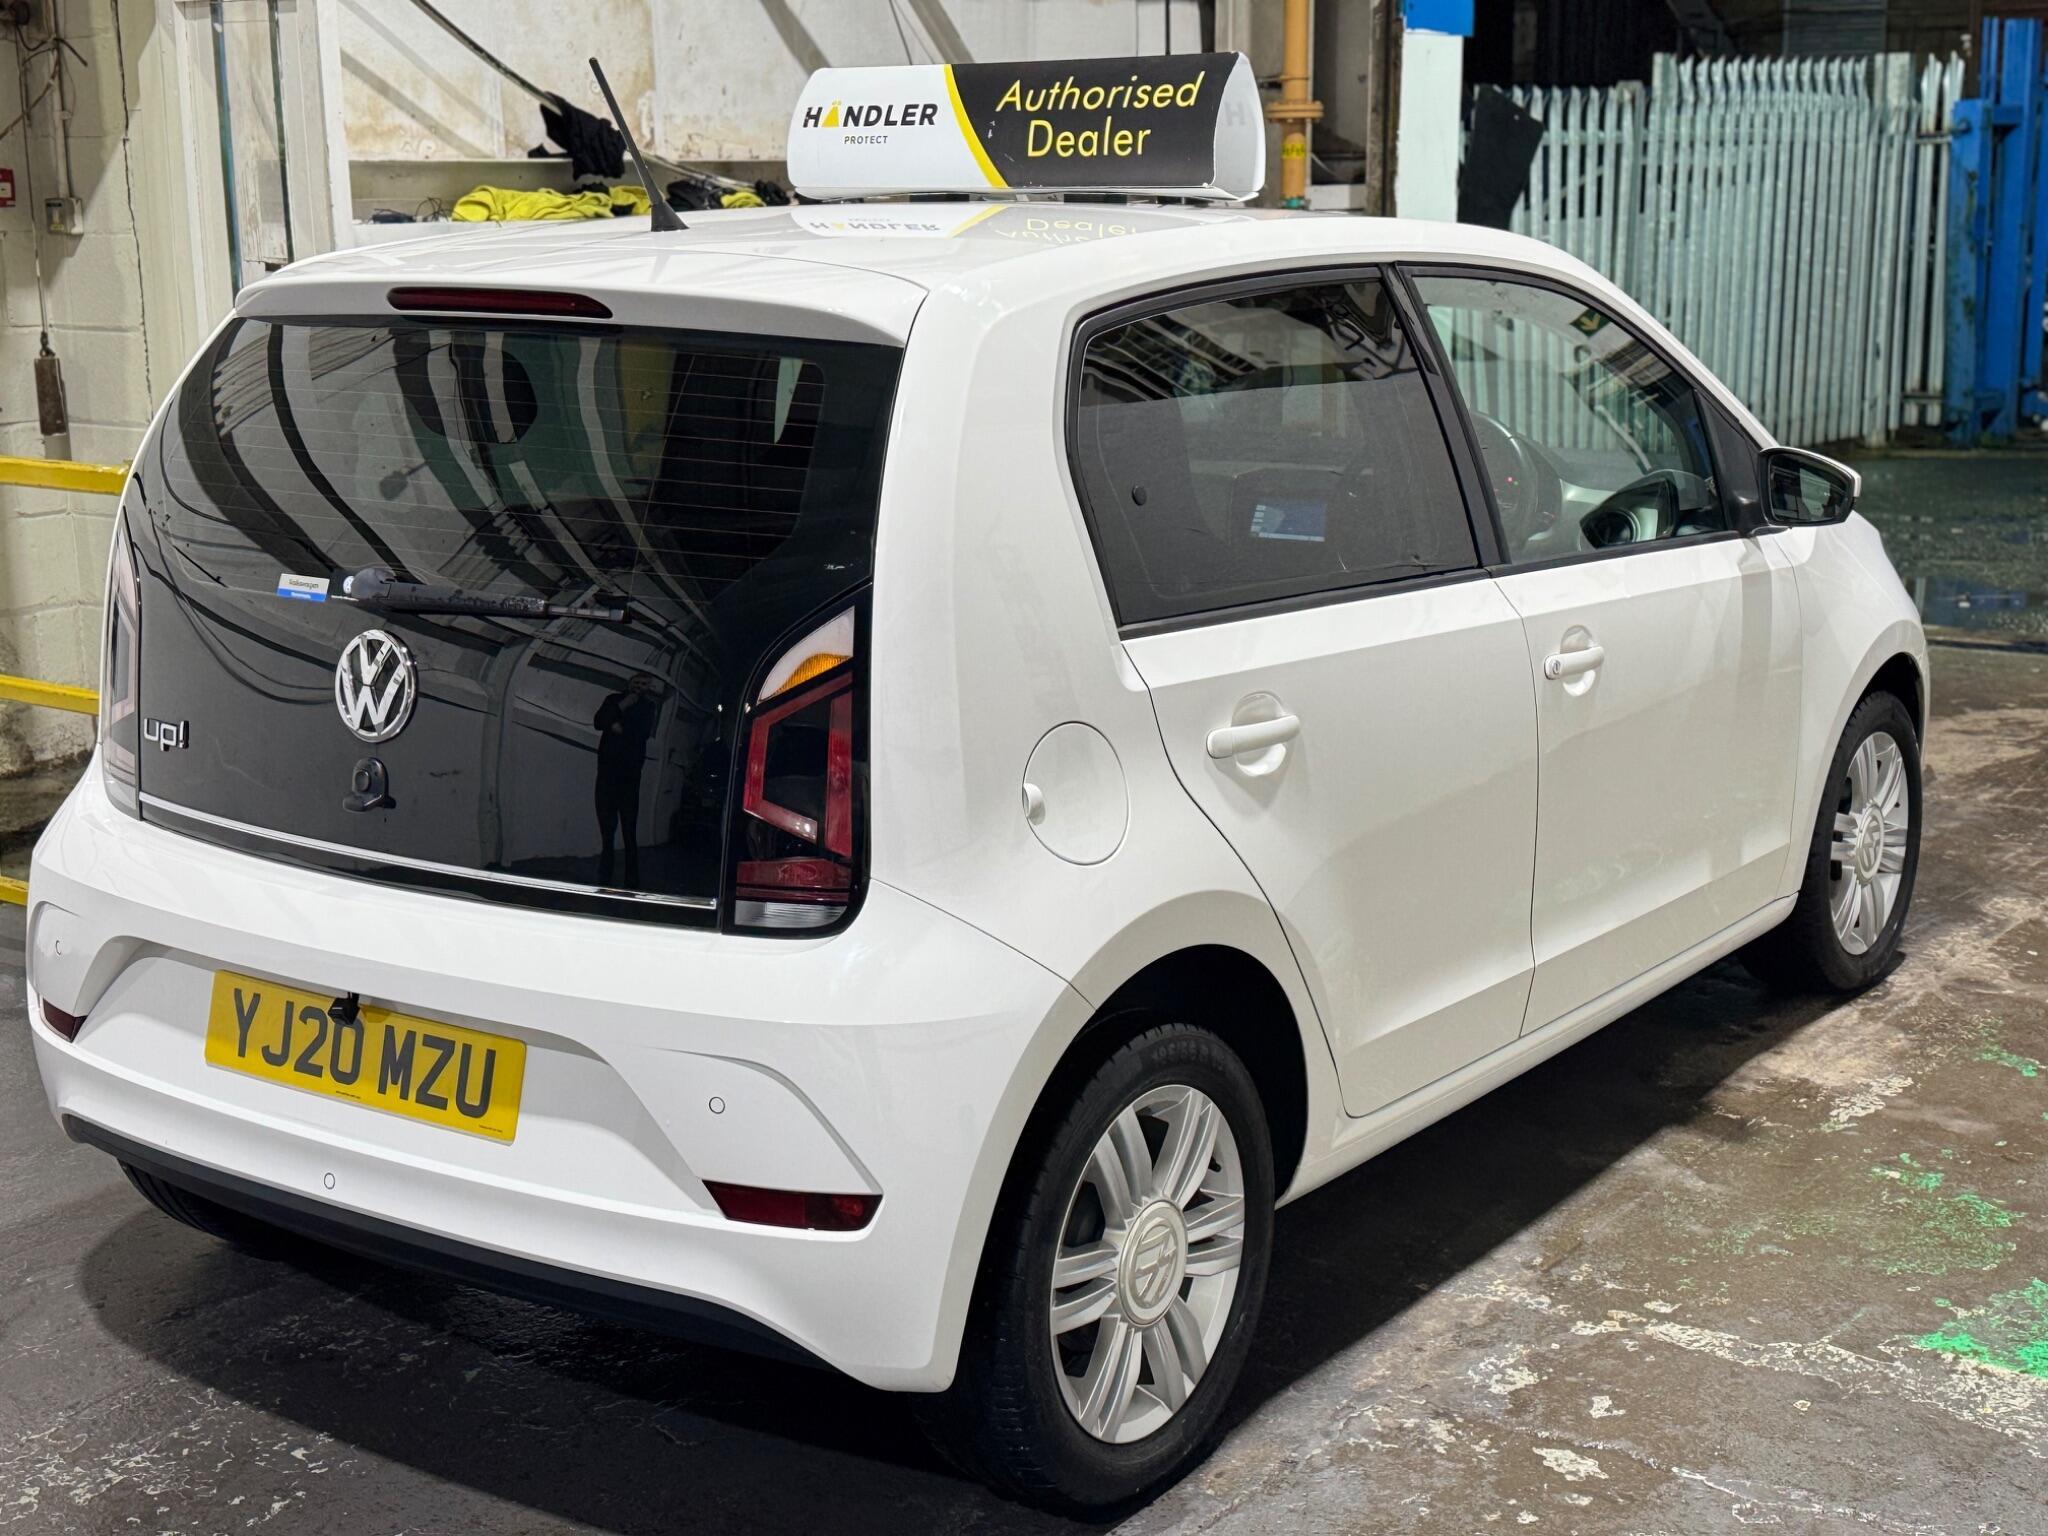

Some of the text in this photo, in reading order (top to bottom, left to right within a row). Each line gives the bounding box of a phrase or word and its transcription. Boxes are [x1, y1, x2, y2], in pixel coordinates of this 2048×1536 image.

[996, 71, 1205, 112] Authorised
[844, 135, 888, 145] PROTECT
[1028, 116, 1151, 157] Dealer
[144, 717, 189, 751] up!
[234, 987, 496, 1119] YJ20 MZU
